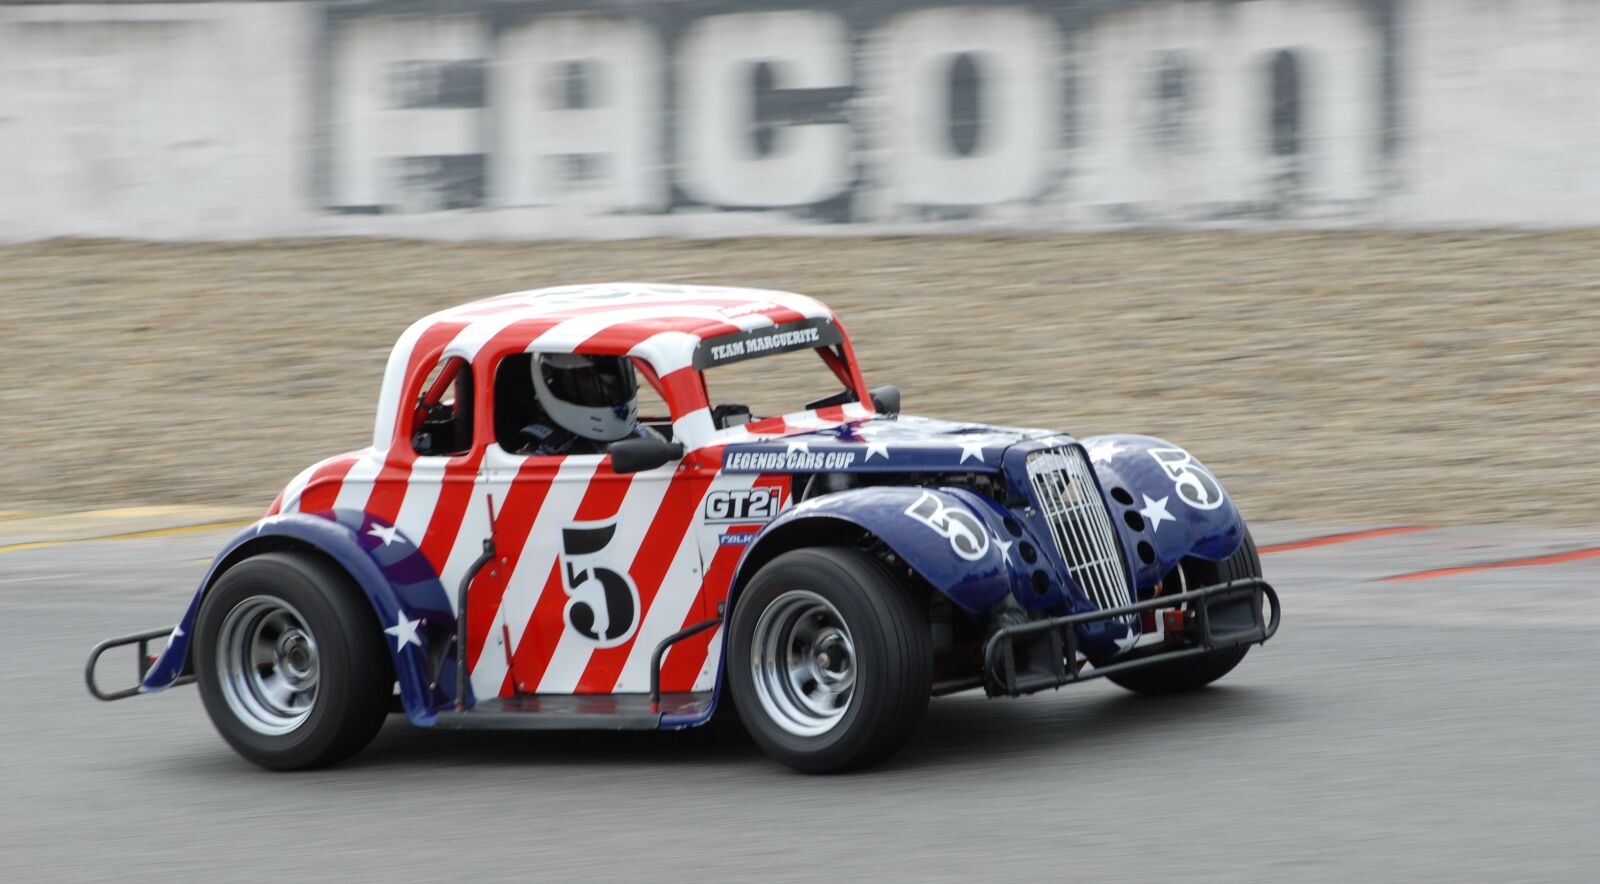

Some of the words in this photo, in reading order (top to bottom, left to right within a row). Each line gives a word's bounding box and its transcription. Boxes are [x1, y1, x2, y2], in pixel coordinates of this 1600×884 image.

[710, 342, 745, 361] TEAM
[746, 327, 820, 354] MARGUERITE
[725, 452, 788, 470] LEGENDS
[786, 452, 825, 470] CARS
[824, 452, 855, 470] CUP
[1148, 447, 1224, 510] 5
[904, 490, 990, 561] 5
[560, 520, 638, 645] 5
